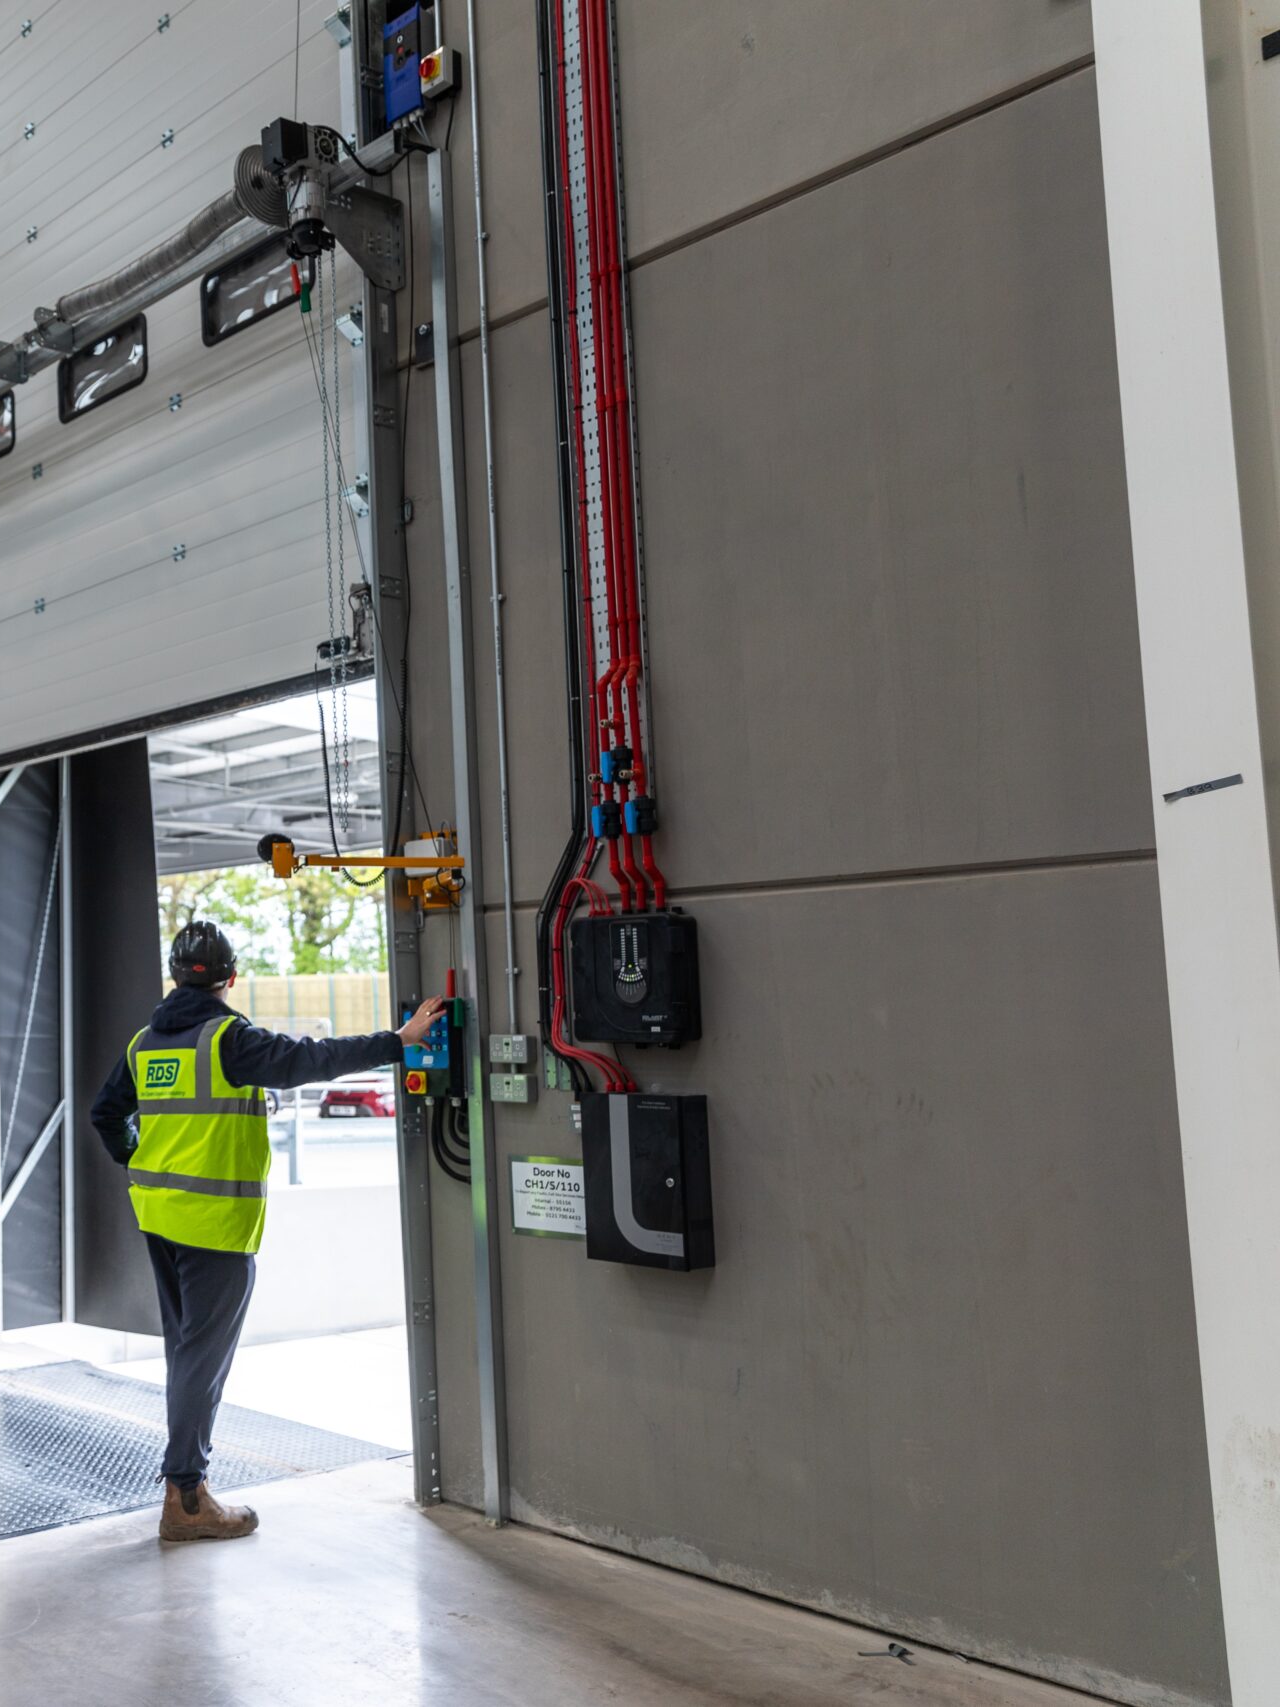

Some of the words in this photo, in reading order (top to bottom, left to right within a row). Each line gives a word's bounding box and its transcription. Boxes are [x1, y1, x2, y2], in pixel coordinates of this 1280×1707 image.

[146, 1065, 174, 1081] RDS
[533, 1167, 555, 1178] Door
[557, 1169, 570, 1179] No
[525, 1179, 580, 1192] CH1/S/110
